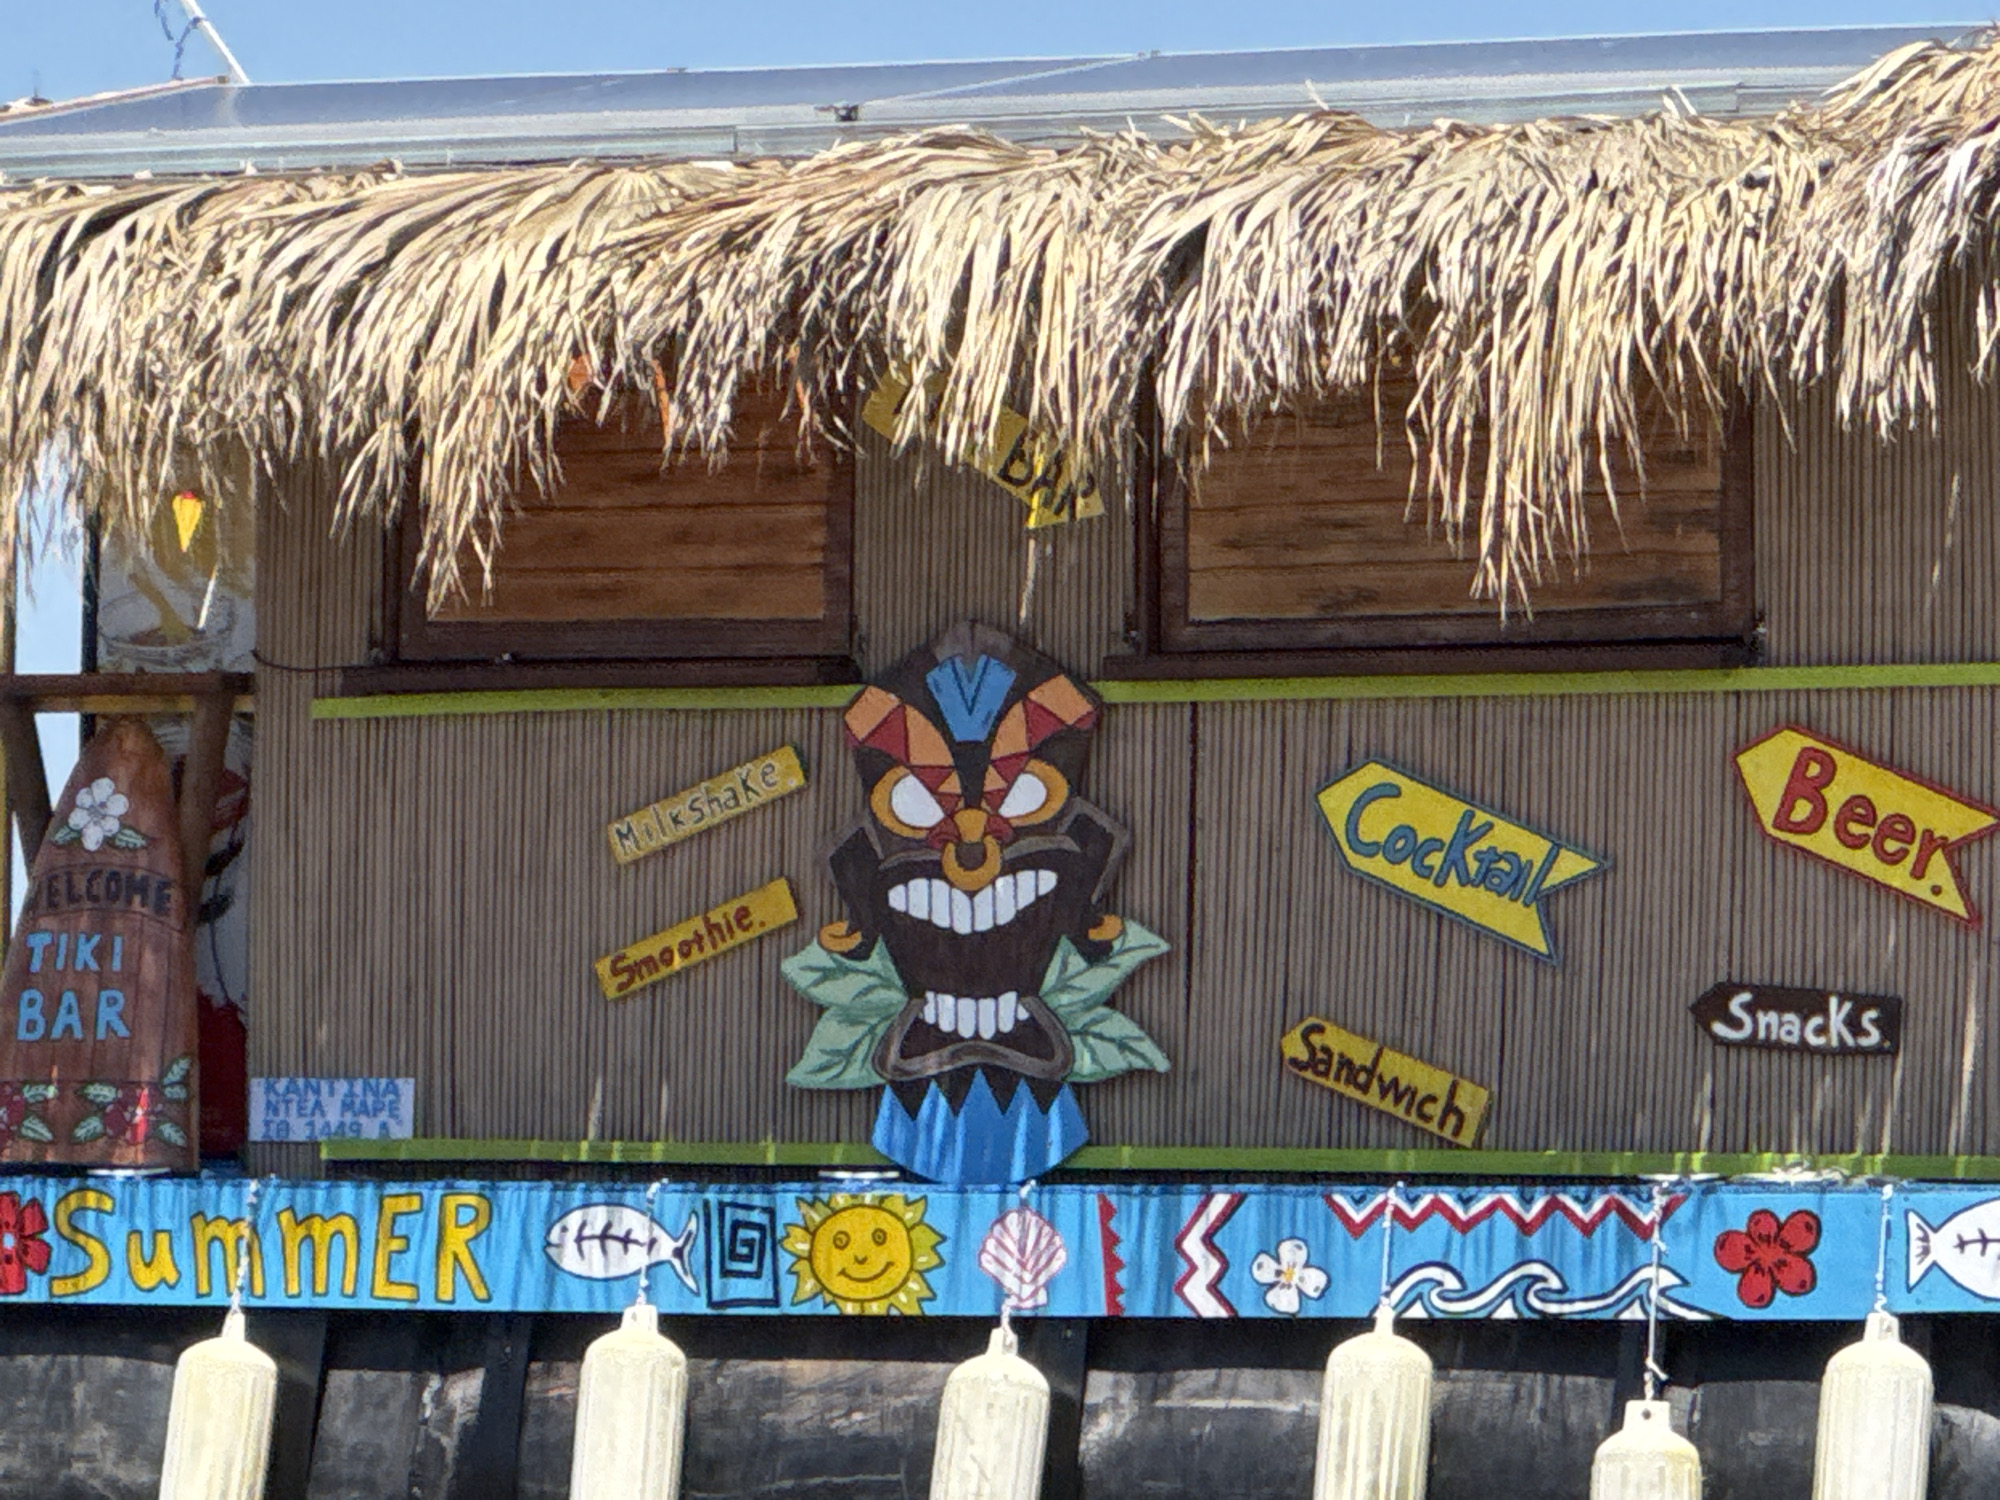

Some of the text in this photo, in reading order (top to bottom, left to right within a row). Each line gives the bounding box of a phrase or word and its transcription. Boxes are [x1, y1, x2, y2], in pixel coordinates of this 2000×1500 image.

[1771, 746, 1949, 897] Beer.
[40, 869, 172, 917] ELCOME
[26, 931, 123, 973] TIKI
[16, 988, 130, 1042] BAR
[1288, 1022, 1470, 1138] Sandwich
